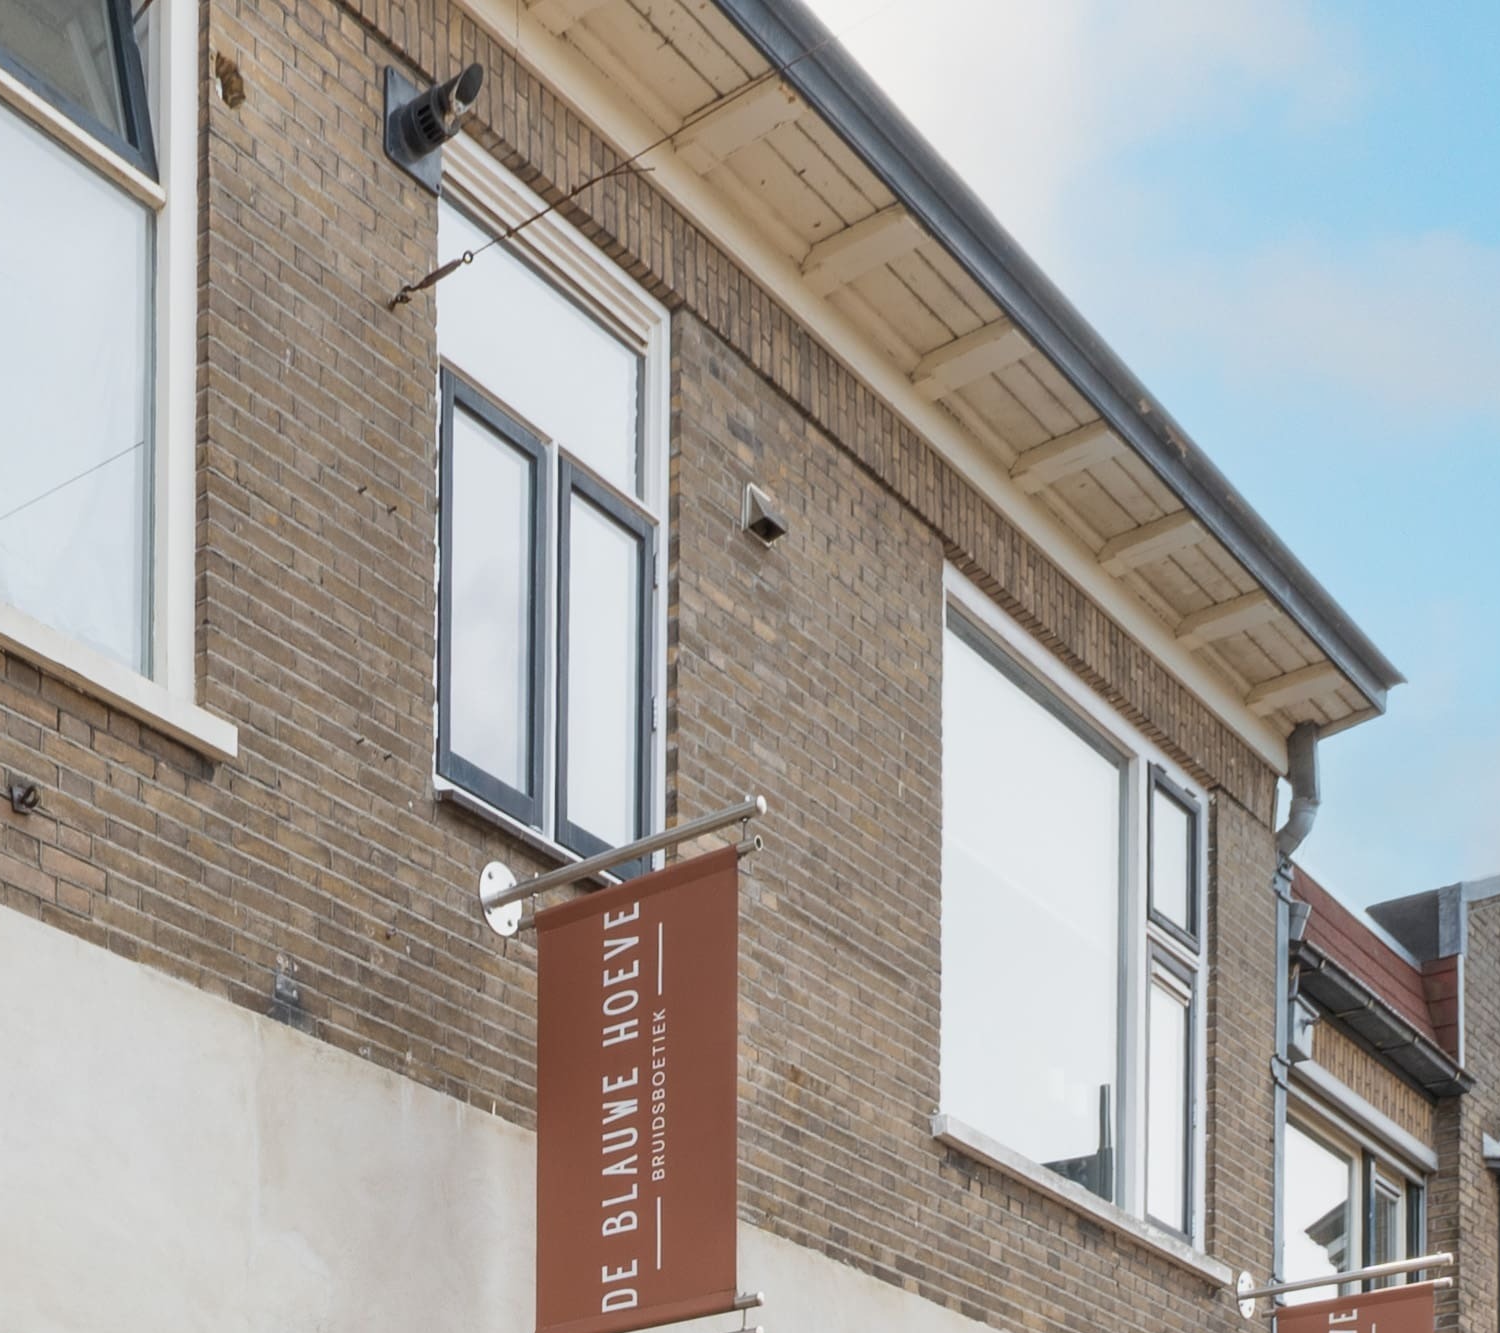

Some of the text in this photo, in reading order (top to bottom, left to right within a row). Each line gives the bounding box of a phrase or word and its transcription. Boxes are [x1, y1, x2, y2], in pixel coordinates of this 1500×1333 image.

[602, 901, 640, 1313] DE BLAUWE HOEVE
[652, 1008, 667, 1181] BRUIDSBOETIEK
